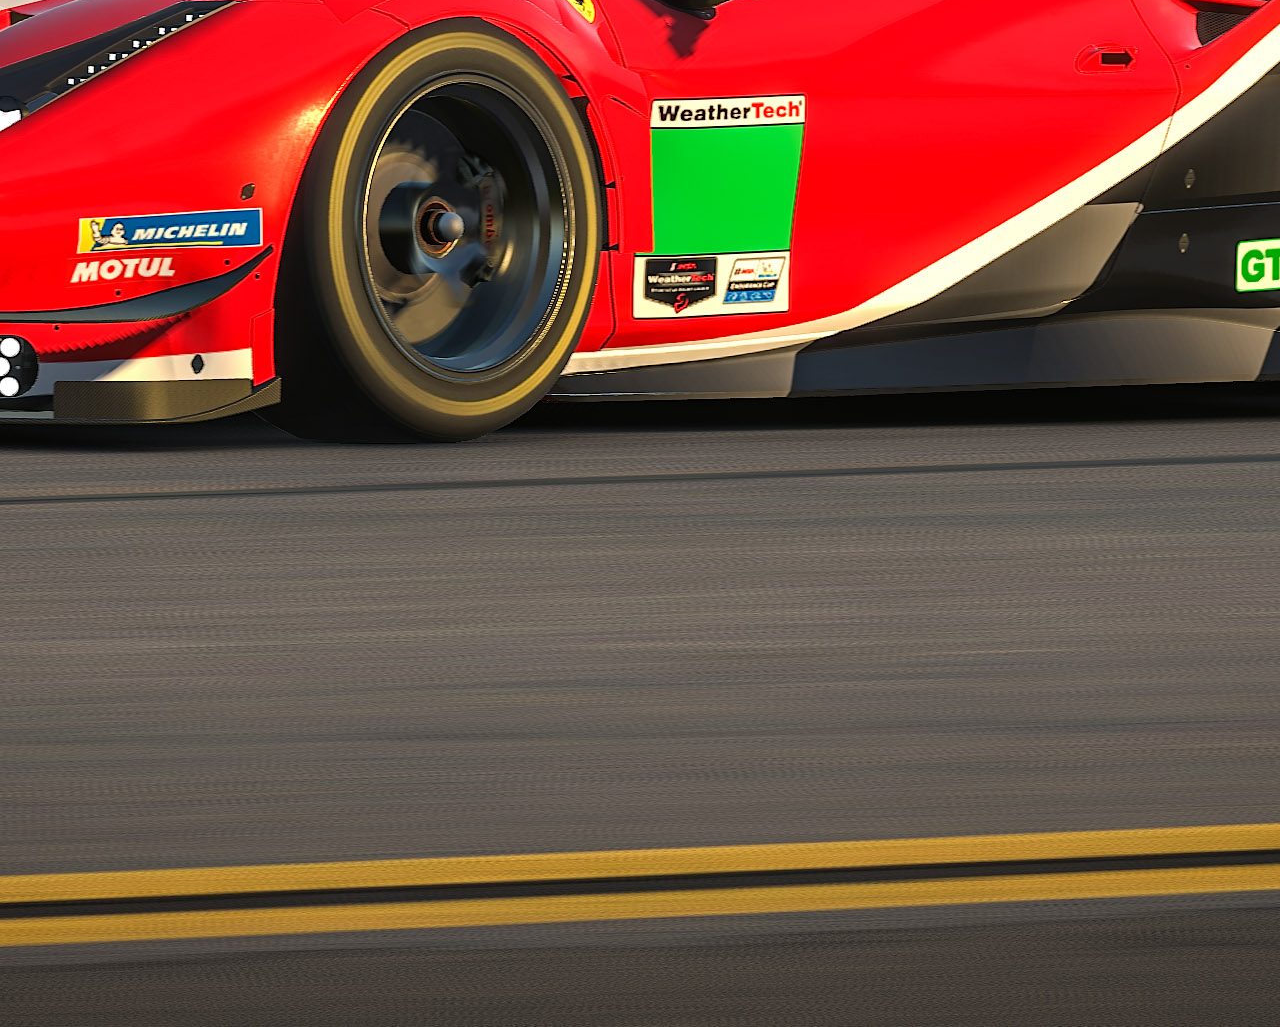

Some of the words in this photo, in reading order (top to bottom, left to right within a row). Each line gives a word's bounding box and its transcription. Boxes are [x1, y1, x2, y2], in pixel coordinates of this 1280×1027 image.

[658, 101, 801, 122] WeatherTech
[131, 222, 248, 241] MICHELIN
[70, 257, 175, 283] MOTUL
[647, 274, 714, 284] WeatherTech
